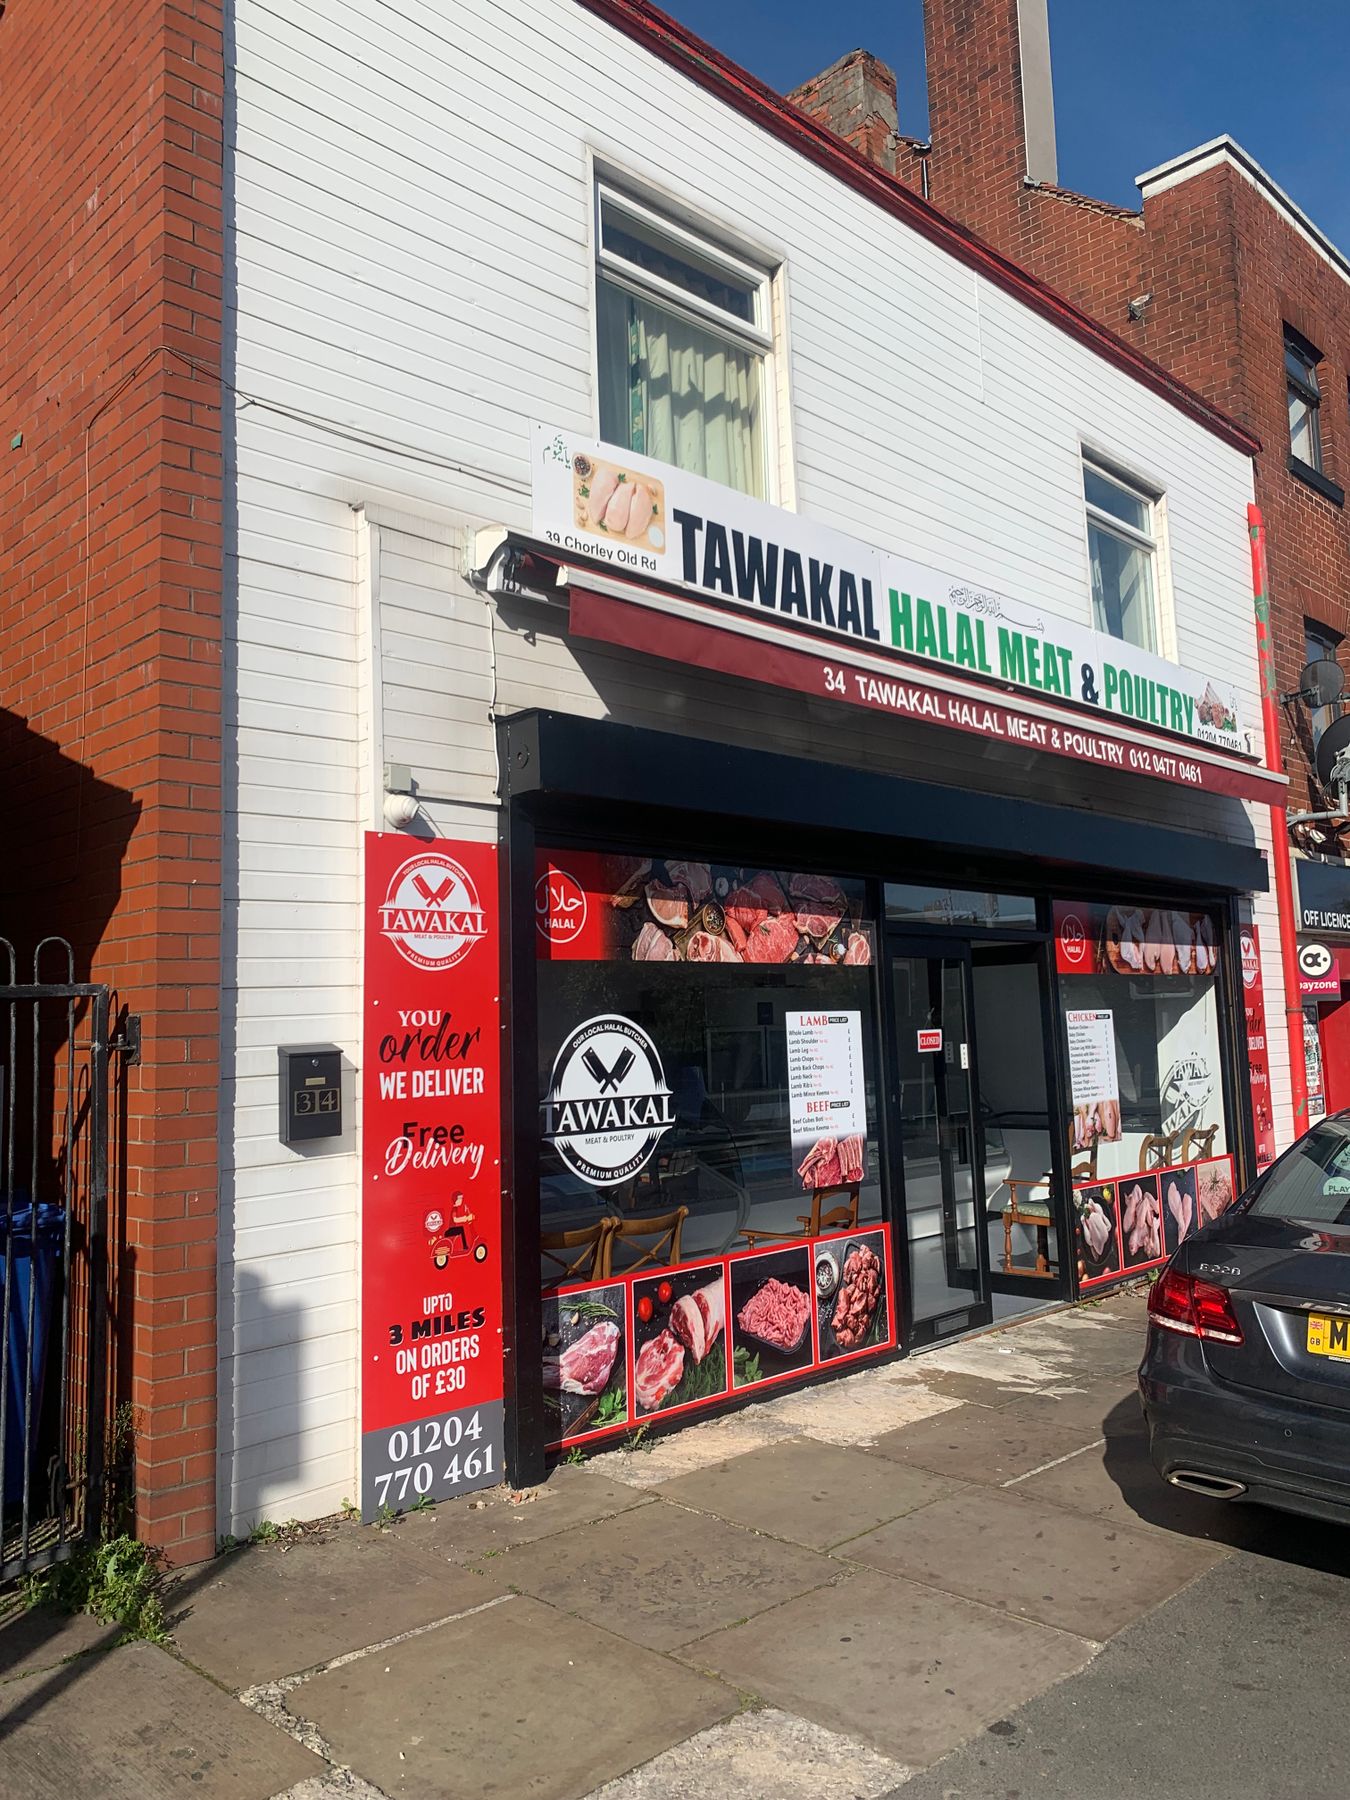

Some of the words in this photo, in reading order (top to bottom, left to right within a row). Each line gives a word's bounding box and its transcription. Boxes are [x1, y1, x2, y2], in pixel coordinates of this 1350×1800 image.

[564, 535, 614, 560] Chorley
[617, 549, 638, 566] Old
[641, 556, 657, 571] Rd
[673, 508, 880, 642] TAWAKAL
[888, 588, 992, 673] HALAL
[997, 627, 1073, 698] MEAT
[1080, 663, 1099, 703] &
[1103, 662, 1195, 736] POULTRY
[823, 666, 846, 695] 34
[855, 675, 947, 719] TAWAKAL
[948, 700, 1005, 735] HALAL
[1006, 715, 1047, 745] MEAT
[1051, 728, 1061, 750] &
[1064, 732, 1124, 764] POULTRY
[1130, 749, 1151, 771] 012
[1152, 755, 1176, 777] 0477
[1179, 762, 1202, 784] 0461
[415, 858, 430, 868] LOCAL
[430, 858, 447, 867] HALAL
[446, 862, 466, 881] BUTCHER
[535, 884, 583, 914] حلال
[377, 908, 489, 934] TAWAKAL
[544, 918, 576, 929] HALAL
[1303, 909, 1319, 926] OFF
[1320, 912, 1350, 929] LICENCE
[406, 949, 436, 967] PREMIUM
[436, 952, 462, 967] QUALITY
[398, 1010, 442, 1028] YOU
[800, 1015, 828, 1027] LAMB
[1068, 1012, 1096, 1023] CHICKEN
[379, 1012, 481, 1064] order
[572, 1033, 586, 1049] OUR
[585, 1024, 605, 1039] LOCAL
[604, 1023, 624, 1034] HALAL
[623, 1026, 648, 1050] BUTCHER
[920, 1036, 940, 1046] CLOSED
[379, 1071, 408, 1100] WE
[411, 1066, 484, 1097] DELIVER
[299, 1090, 337, 1113] 34
[539, 1095, 677, 1135] TAWAKAL
[807, 1101, 829, 1113] BEEF
[402, 1122, 465, 1150] Free
[585, 1137, 602, 1145] MEAT
[609, 1133, 635, 1143] POULTRY
[385, 1136, 484, 1179] Delivery
[576, 1160, 613, 1179] PREMIUM
[613, 1153, 644, 1178] QUALITY
[423, 1292, 453, 1316] UPTO
[388, 1324, 404, 1346] 3
[411, 1306, 487, 1342] MILES
[1329, 1319, 1348, 1351] M
[396, 1346, 418, 1376] ON
[420, 1334, 480, 1367] ORDERS
[1310, 1337, 1321, 1346] GB
[411, 1372, 430, 1401] OF
[435, 1365, 466, 1396] £30
[388, 1410, 483, 1464] 01204
[374, 1461, 434, 1507] 770
[443, 1443, 495, 1485] 461
